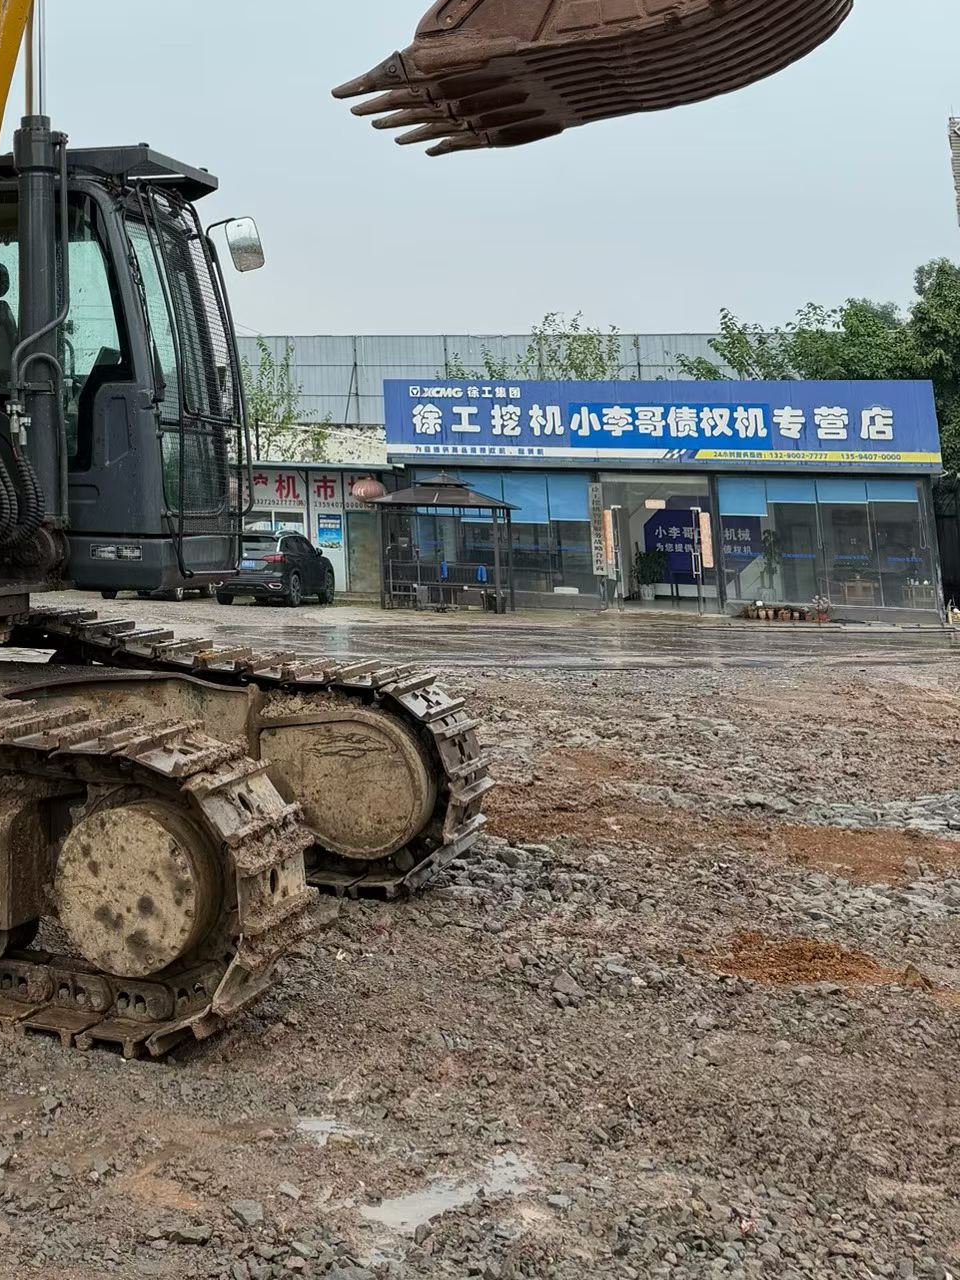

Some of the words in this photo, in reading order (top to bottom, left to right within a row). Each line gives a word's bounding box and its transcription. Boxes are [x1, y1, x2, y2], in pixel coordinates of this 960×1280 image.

[421, 387, 464, 398] XCMG
[466, 386, 521, 398] 徐工集团
[412, 403, 895, 441] 徐工挖机小李哥债权机专营店
